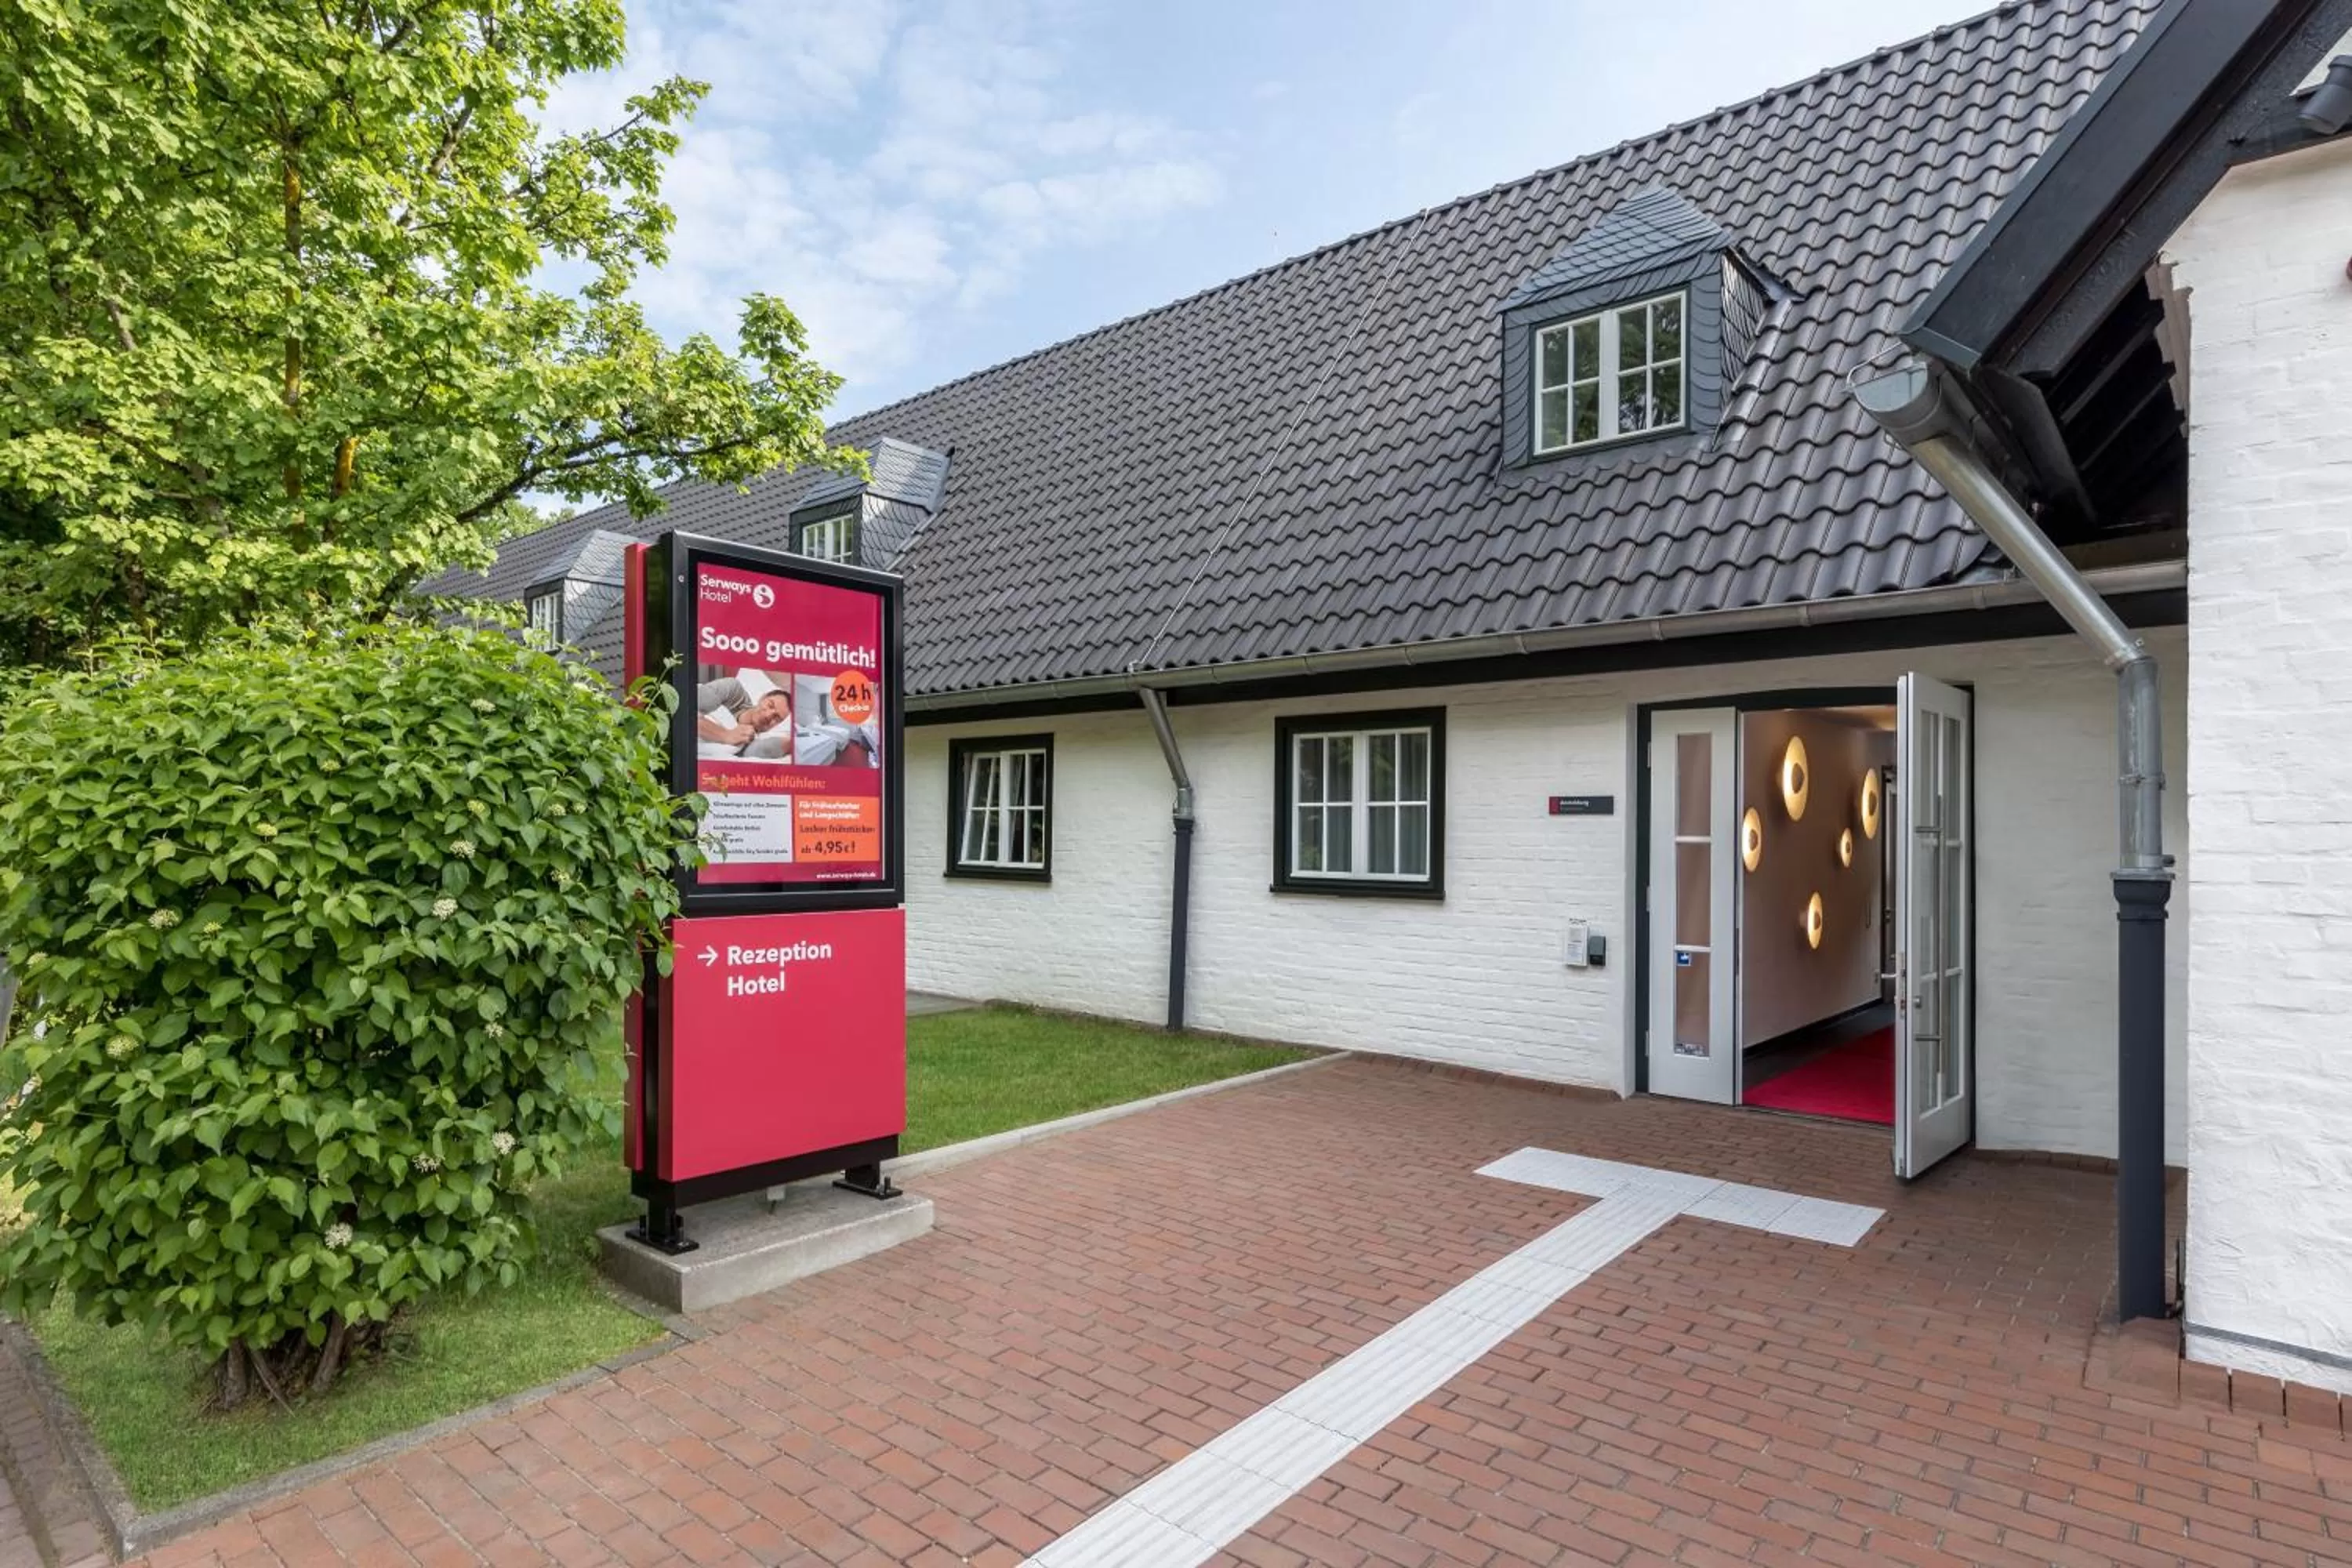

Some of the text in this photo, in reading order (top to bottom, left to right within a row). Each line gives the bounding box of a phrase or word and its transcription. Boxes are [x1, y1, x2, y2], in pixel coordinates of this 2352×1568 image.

[700, 574, 752, 594] Serways
[700, 587, 731, 603] Hotel
[700, 626, 877, 667] Sooo gemütlich!
[835, 682, 871, 702] 24 h
[753, 774, 826, 789] Wohlfühlen:
[727, 940, 832, 967] Rezeption
[727, 971, 785, 996] Hotel
